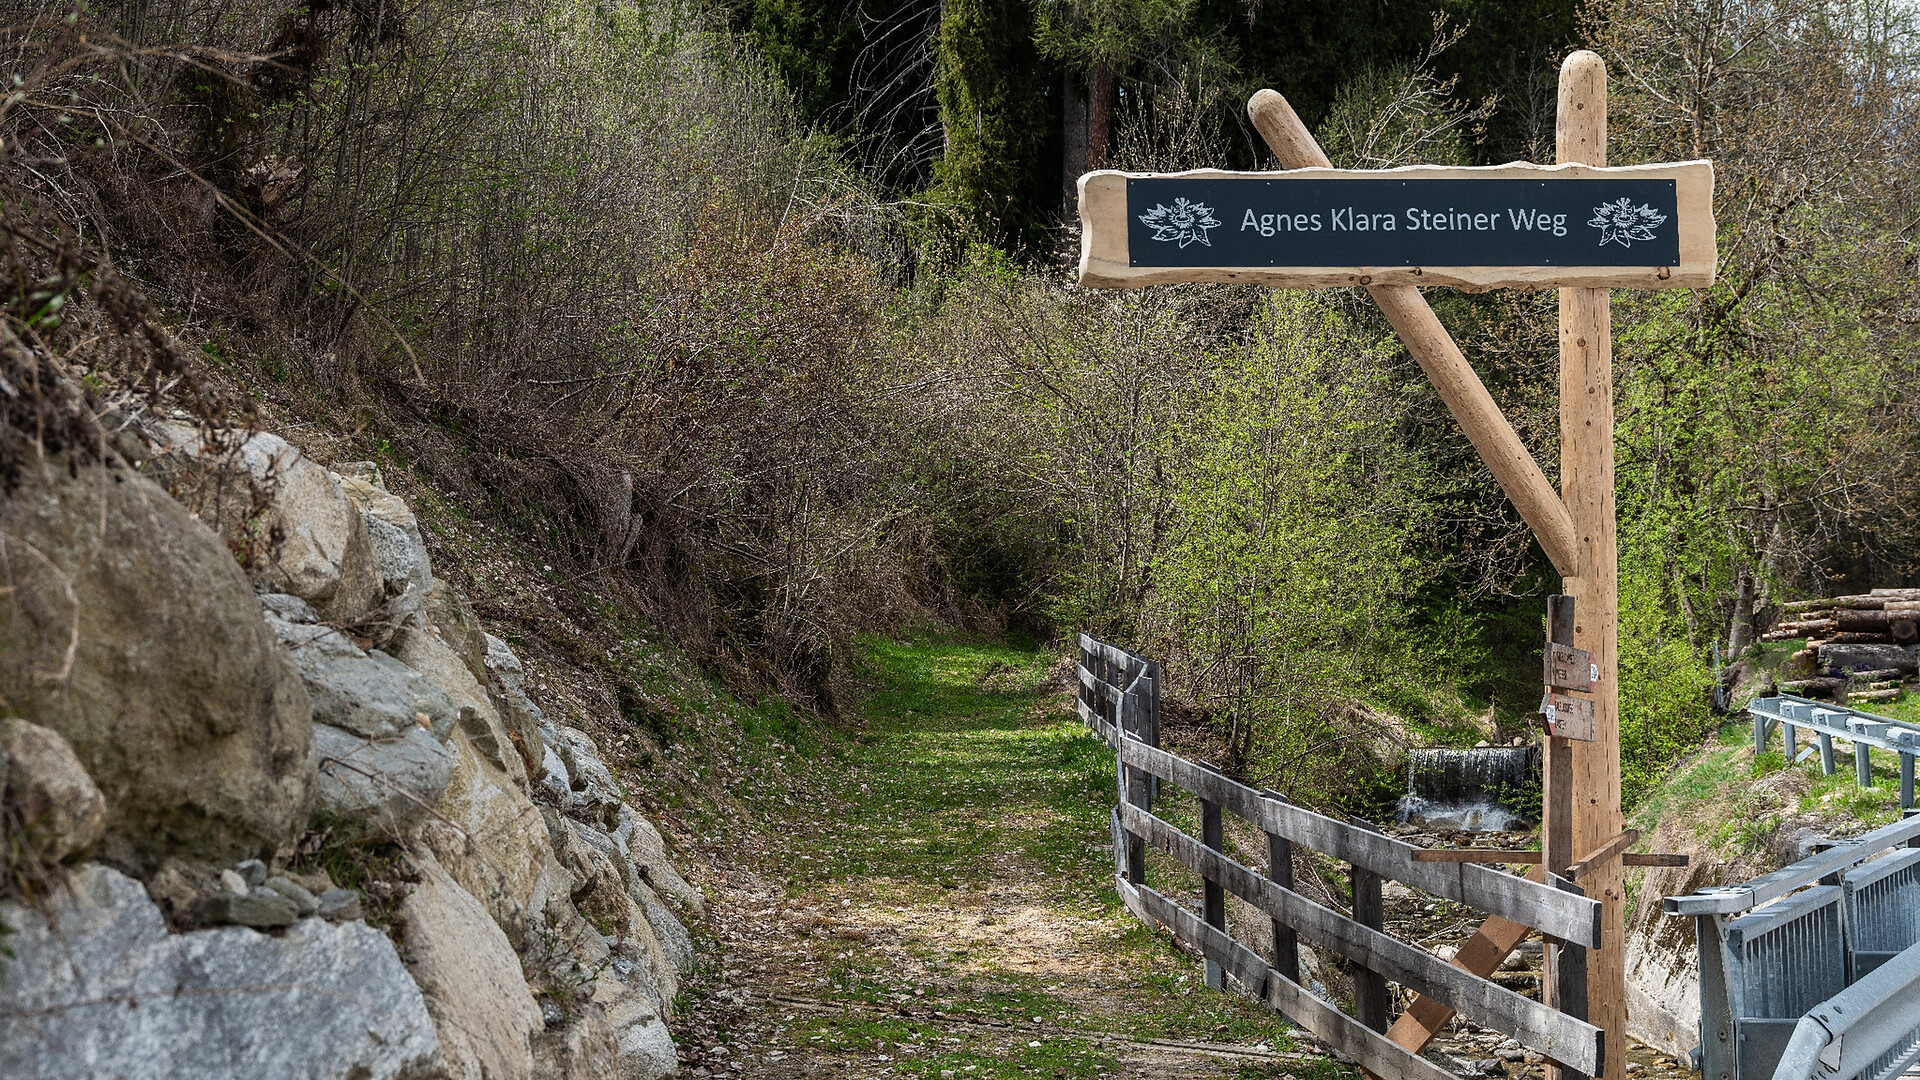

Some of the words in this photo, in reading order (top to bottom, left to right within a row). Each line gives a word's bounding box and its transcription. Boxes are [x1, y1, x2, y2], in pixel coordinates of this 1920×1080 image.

[1240, 208, 1322, 236] Agnes
[1331, 206, 1396, 231] Klara
[1406, 207, 1500, 231] Steiner
[1508, 208, 1567, 236] Weg
